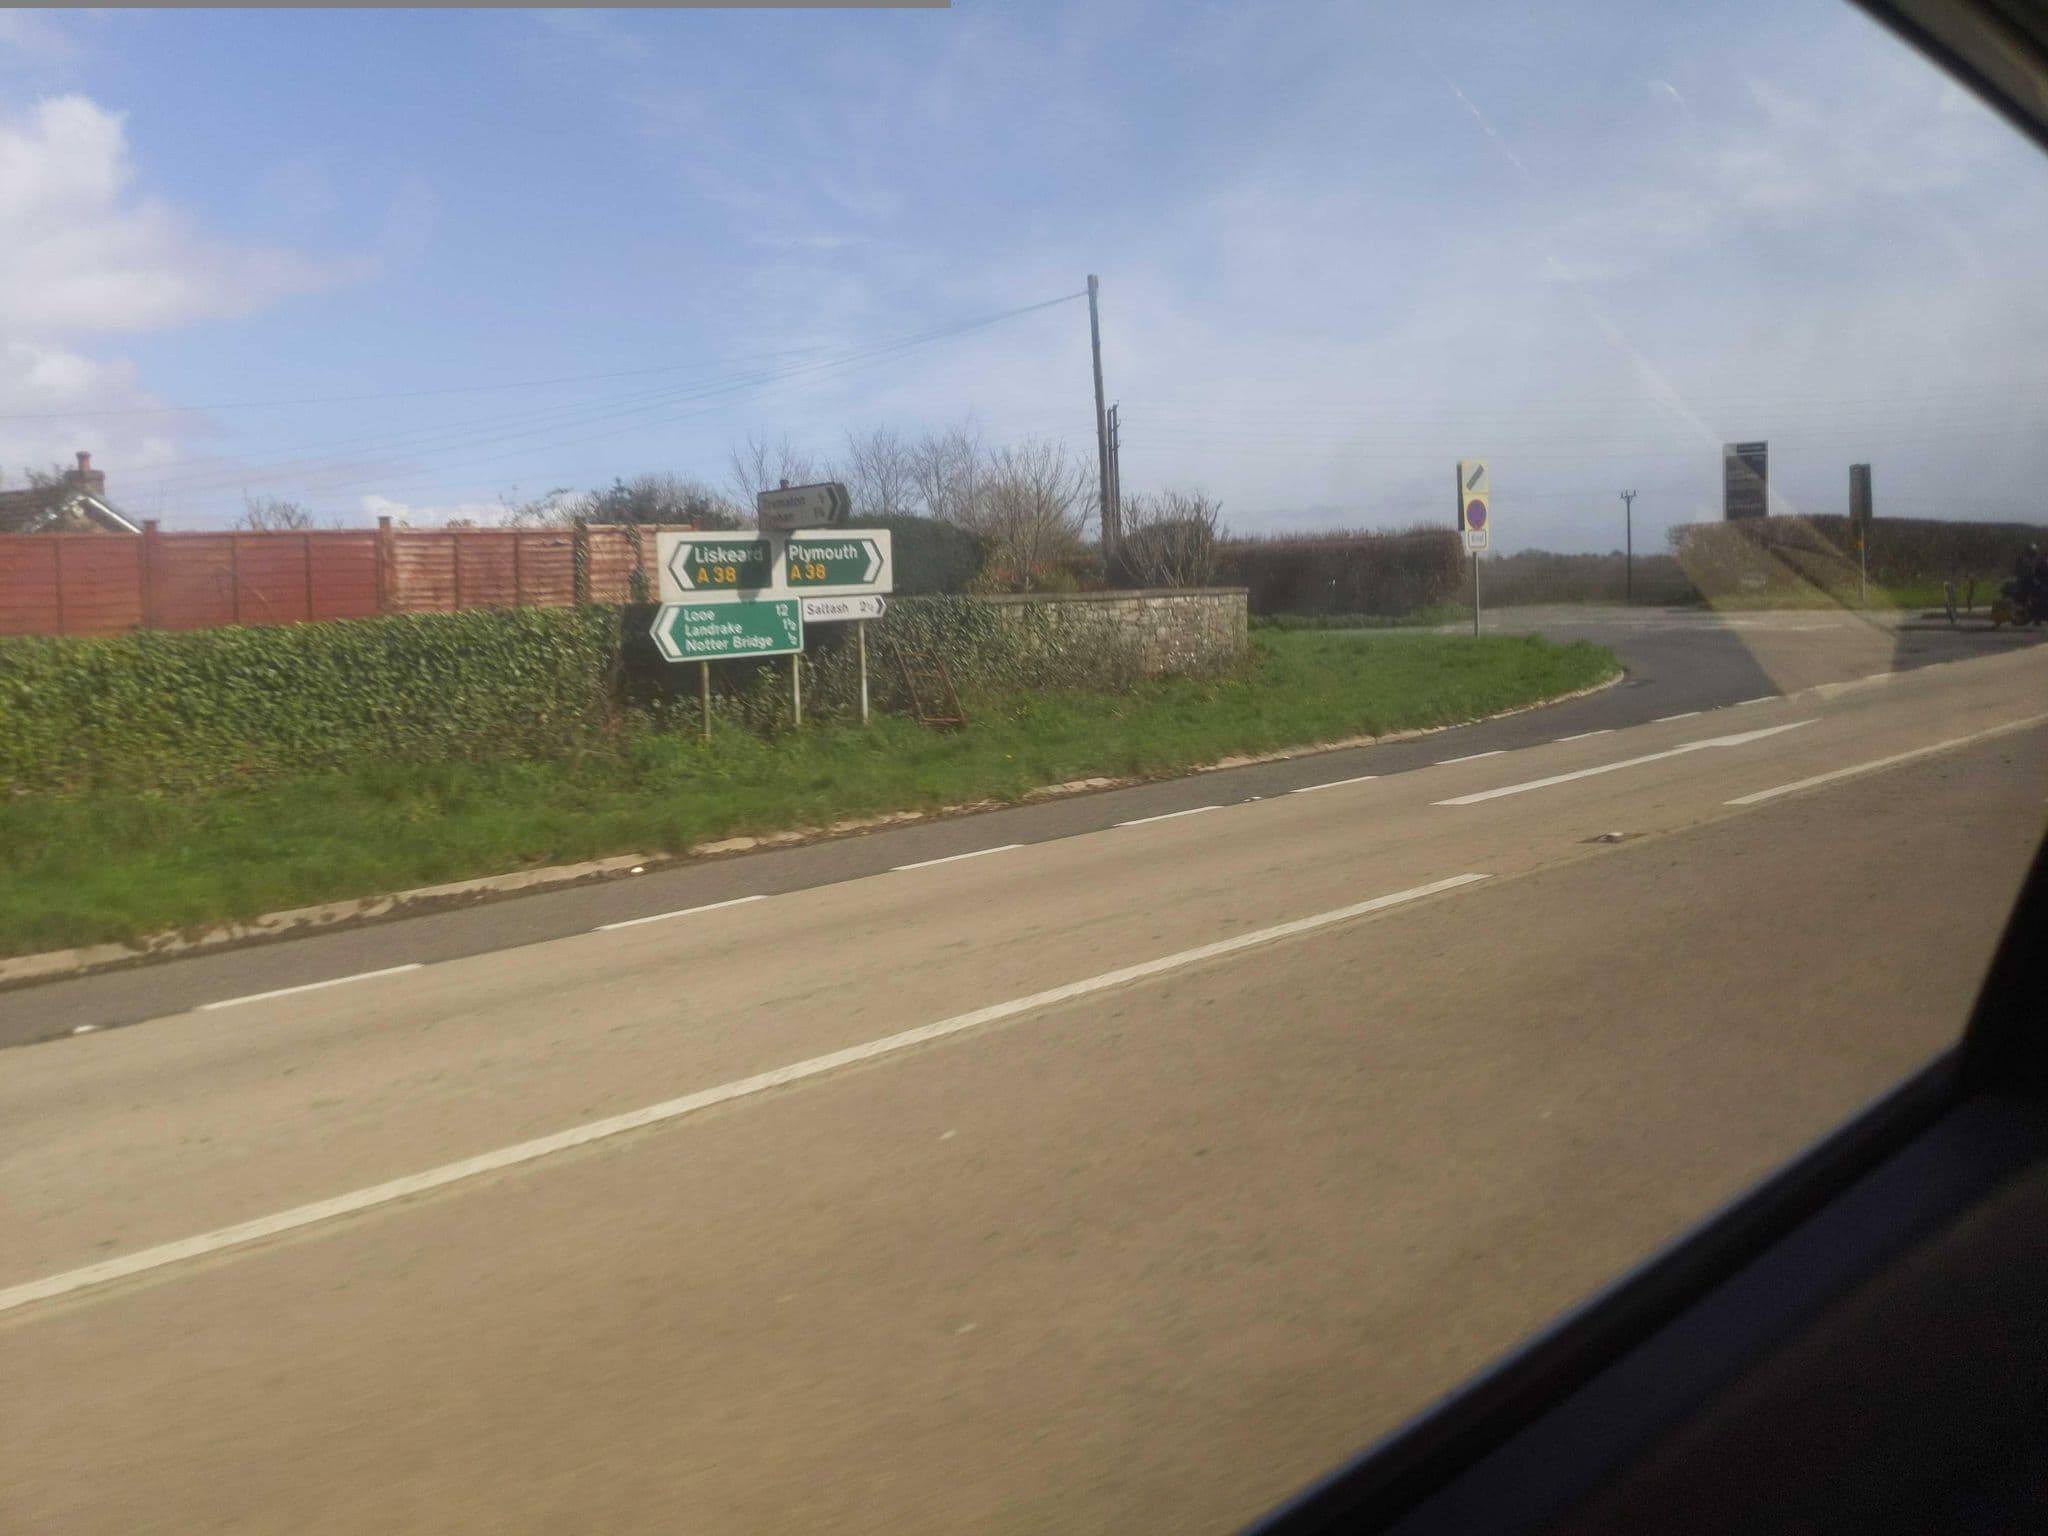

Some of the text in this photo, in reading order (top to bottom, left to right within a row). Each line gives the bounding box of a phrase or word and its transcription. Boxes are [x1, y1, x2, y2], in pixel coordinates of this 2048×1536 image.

[695, 545, 763, 563] Liskeard
[788, 544, 858, 562] Plymouth
[696, 566, 737, 583] A 38
[790, 563, 826, 581] A 38
[683, 608, 715, 622] Looe
[807, 602, 849, 616] Saltash
[684, 622, 743, 637] Landrake
[685, 638, 729, 652] Notter
[732, 634, 774, 649] Bridge
